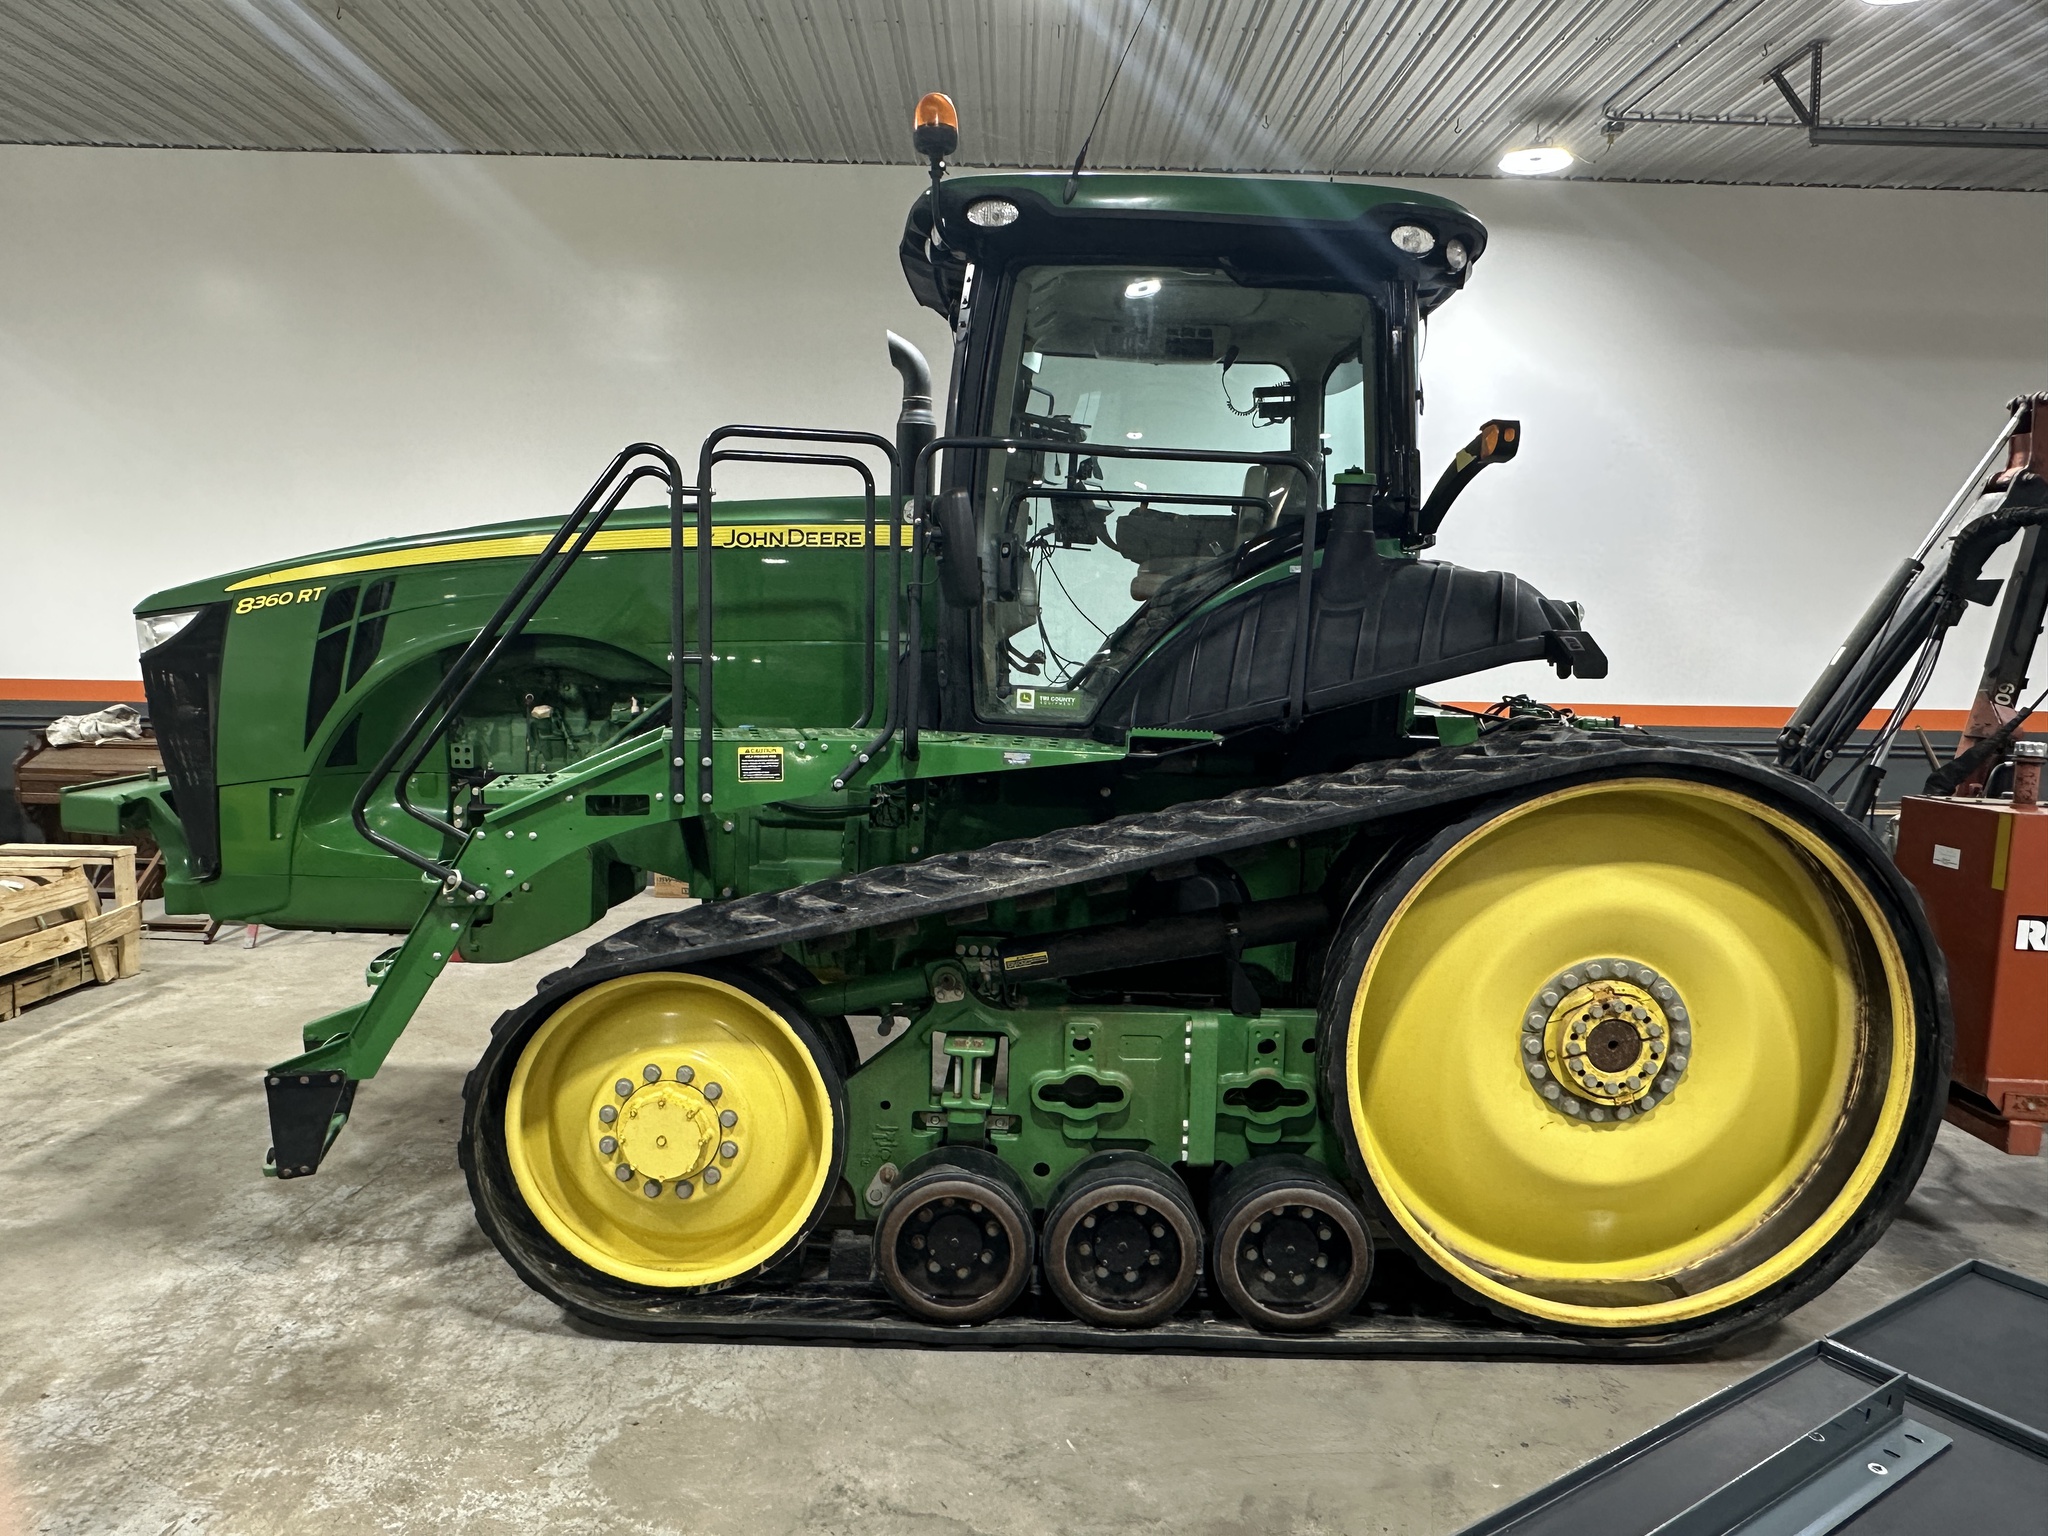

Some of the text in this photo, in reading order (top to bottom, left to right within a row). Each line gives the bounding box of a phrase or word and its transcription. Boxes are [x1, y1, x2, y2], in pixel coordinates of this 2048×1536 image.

[723, 528, 863, 547] JOHN DEERE
[235, 586, 327, 614] 8360 RT
